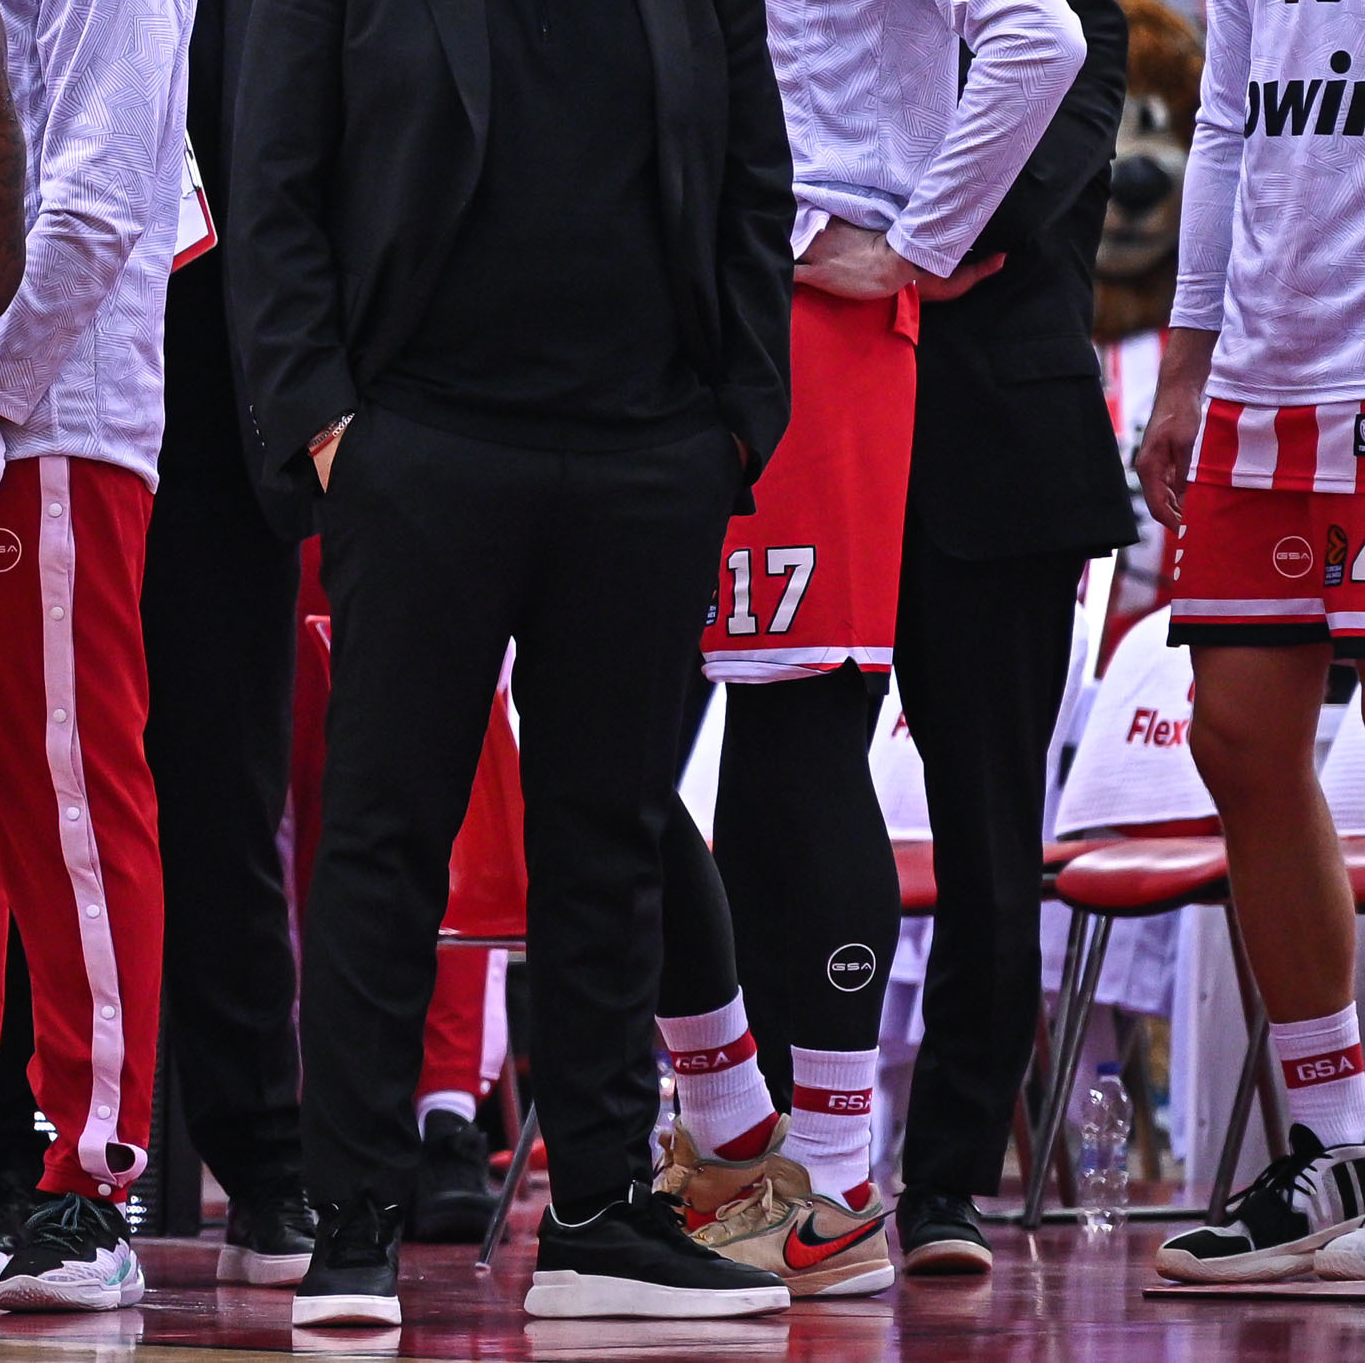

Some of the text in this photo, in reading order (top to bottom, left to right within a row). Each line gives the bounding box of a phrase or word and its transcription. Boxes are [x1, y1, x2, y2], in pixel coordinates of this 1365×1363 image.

[726, 546, 816, 636] 17
[1126, 707, 1191, 748] Flex
[832, 962, 872, 971] GSA
[675, 1051, 730, 1070] GSA
[1297, 1055, 1355, 1081] GSA
